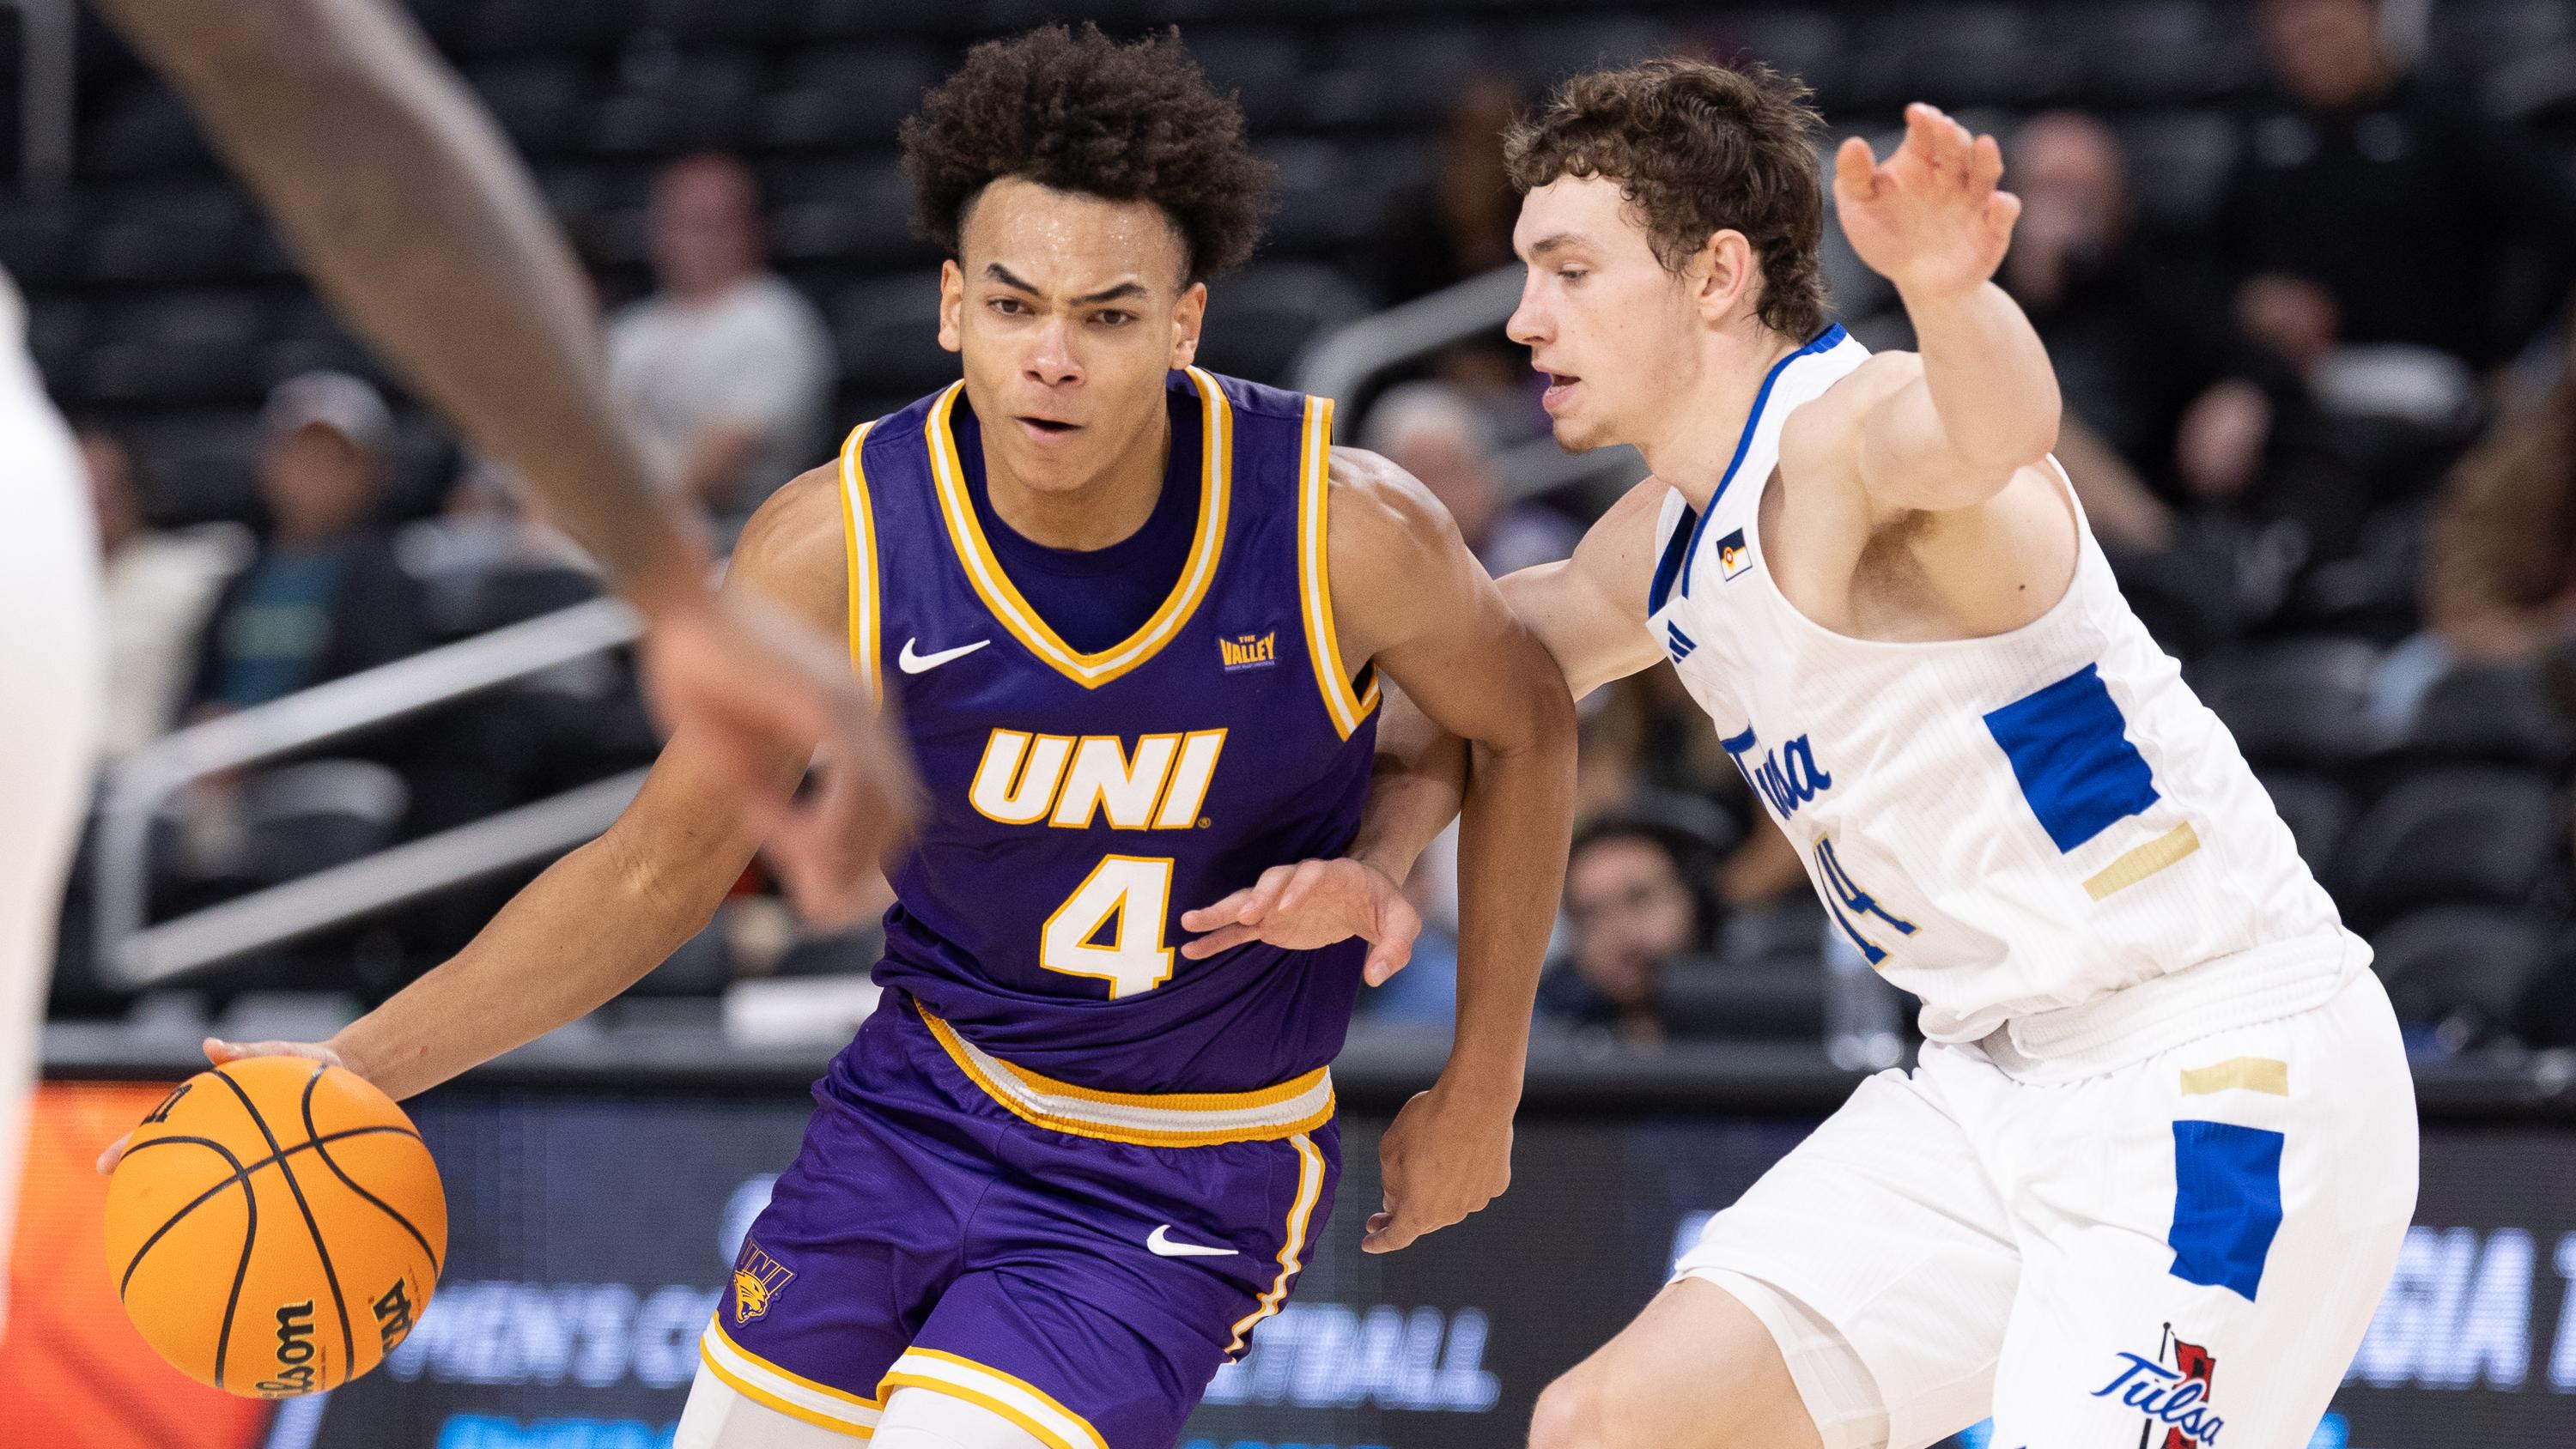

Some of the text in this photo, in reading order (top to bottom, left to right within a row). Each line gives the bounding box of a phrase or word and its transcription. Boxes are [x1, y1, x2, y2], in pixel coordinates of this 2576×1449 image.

[1220, 631, 1275, 665] VALLEY
[1238, 634, 1256, 643] THE
[969, 727, 1228, 831] UNI
[1040, 853, 1176, 1002] 4
[1813, 830, 1923, 971] 14
[2089, 1351, 2225, 1446] Tulsa
